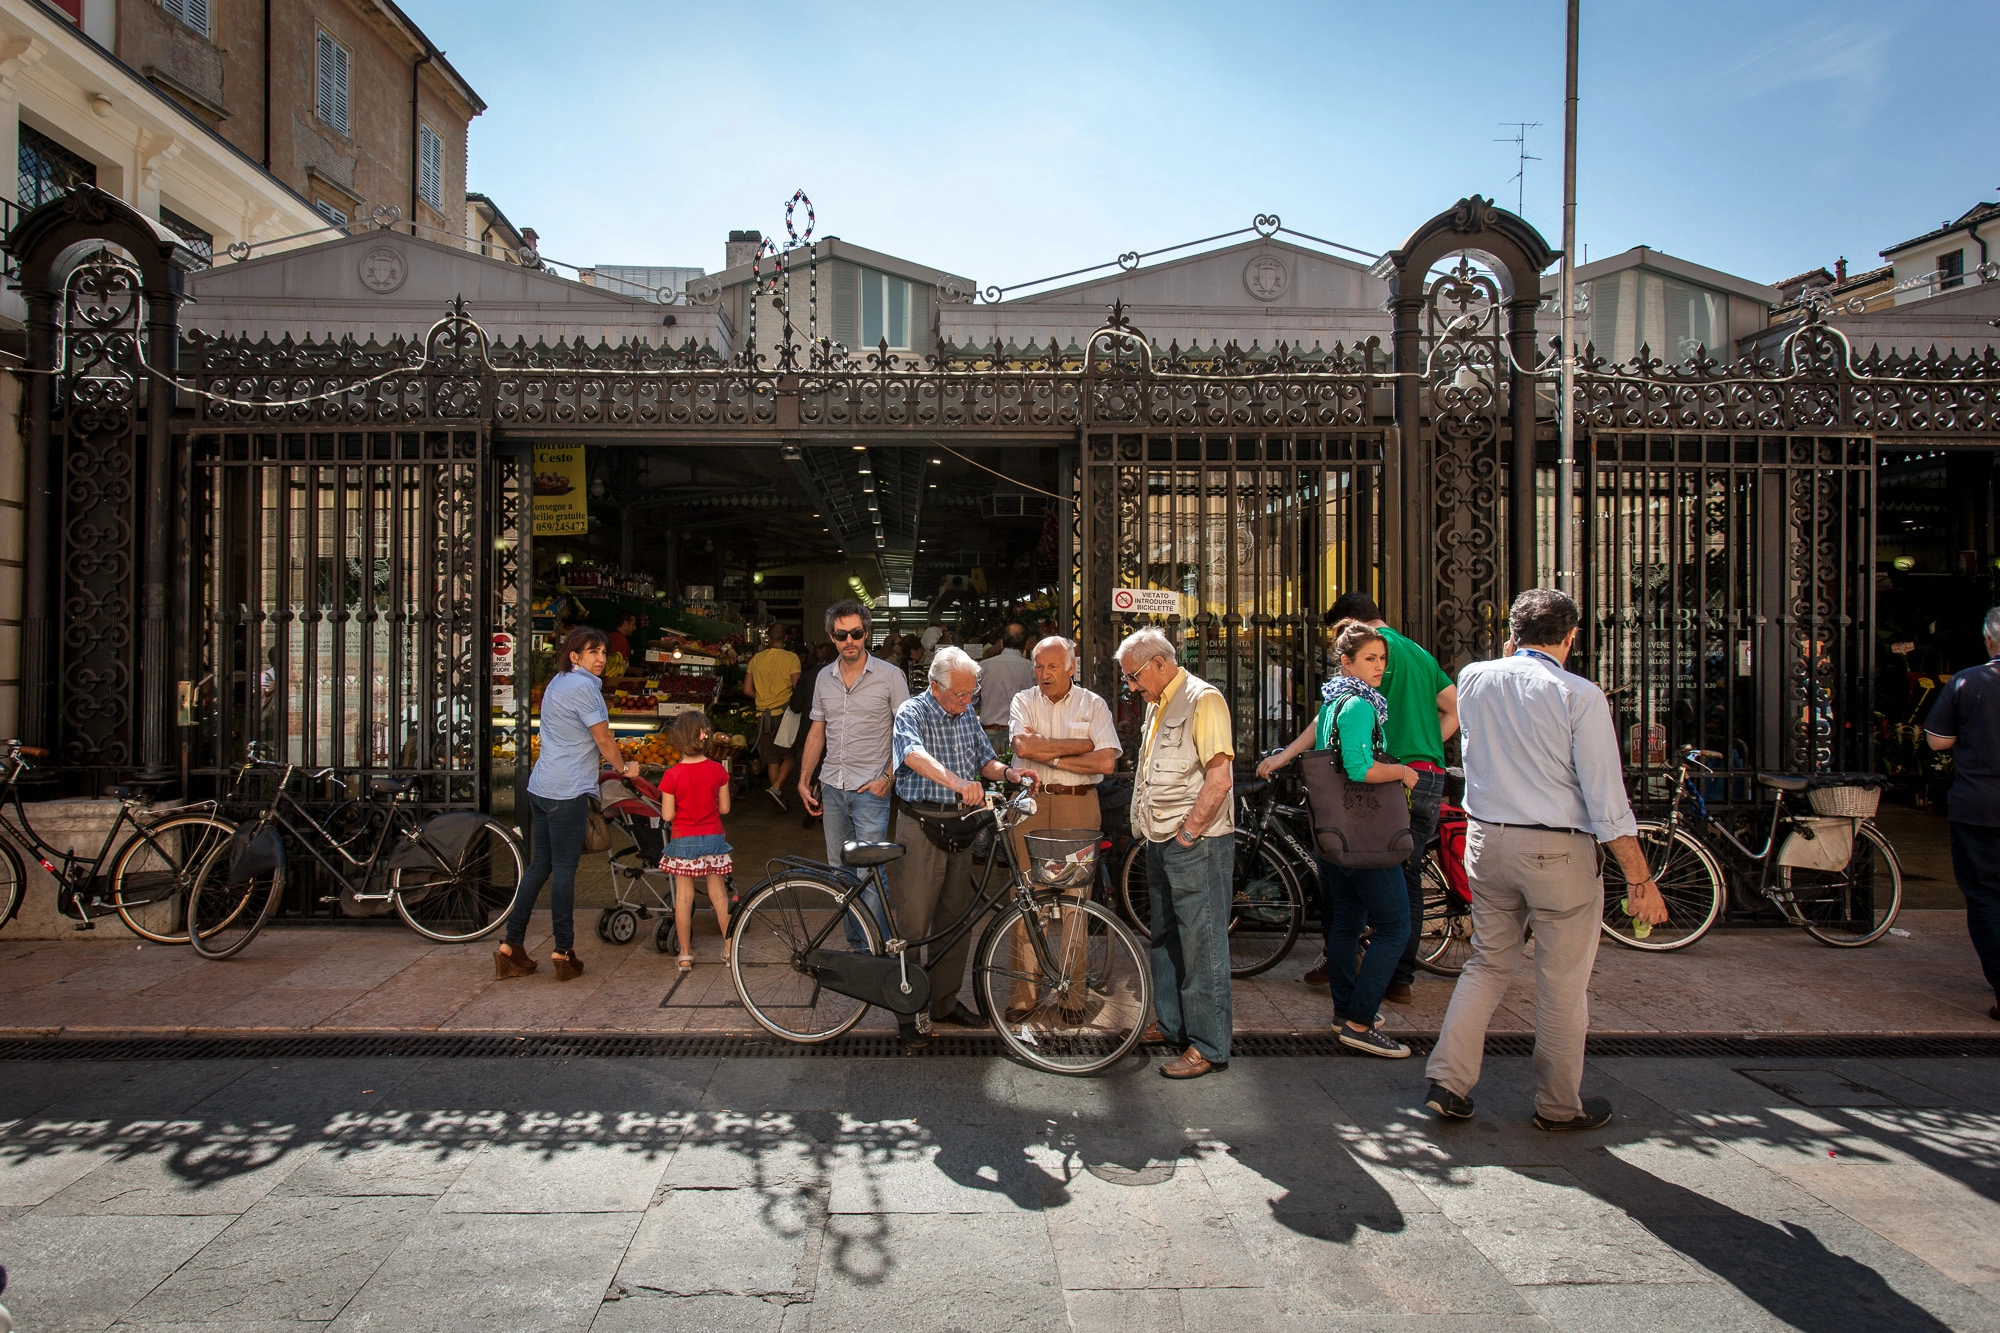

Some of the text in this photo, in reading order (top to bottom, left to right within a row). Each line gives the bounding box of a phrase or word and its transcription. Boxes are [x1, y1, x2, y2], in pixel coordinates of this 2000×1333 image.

[540, 453, 573, 463] Cesto
[534, 504, 566, 512] onsegne
[533, 512, 586, 522] icilio gratuite
[536, 522, 586, 532] 059/245472
[1134, 598, 1176, 606] INTRODURRE
[1209, 640, 1218, 648] DI
[1218, 640, 1251, 648] VEITA
[1344, 780, 1375, 793] Guess
[1356, 795, 1362, 806] ?
